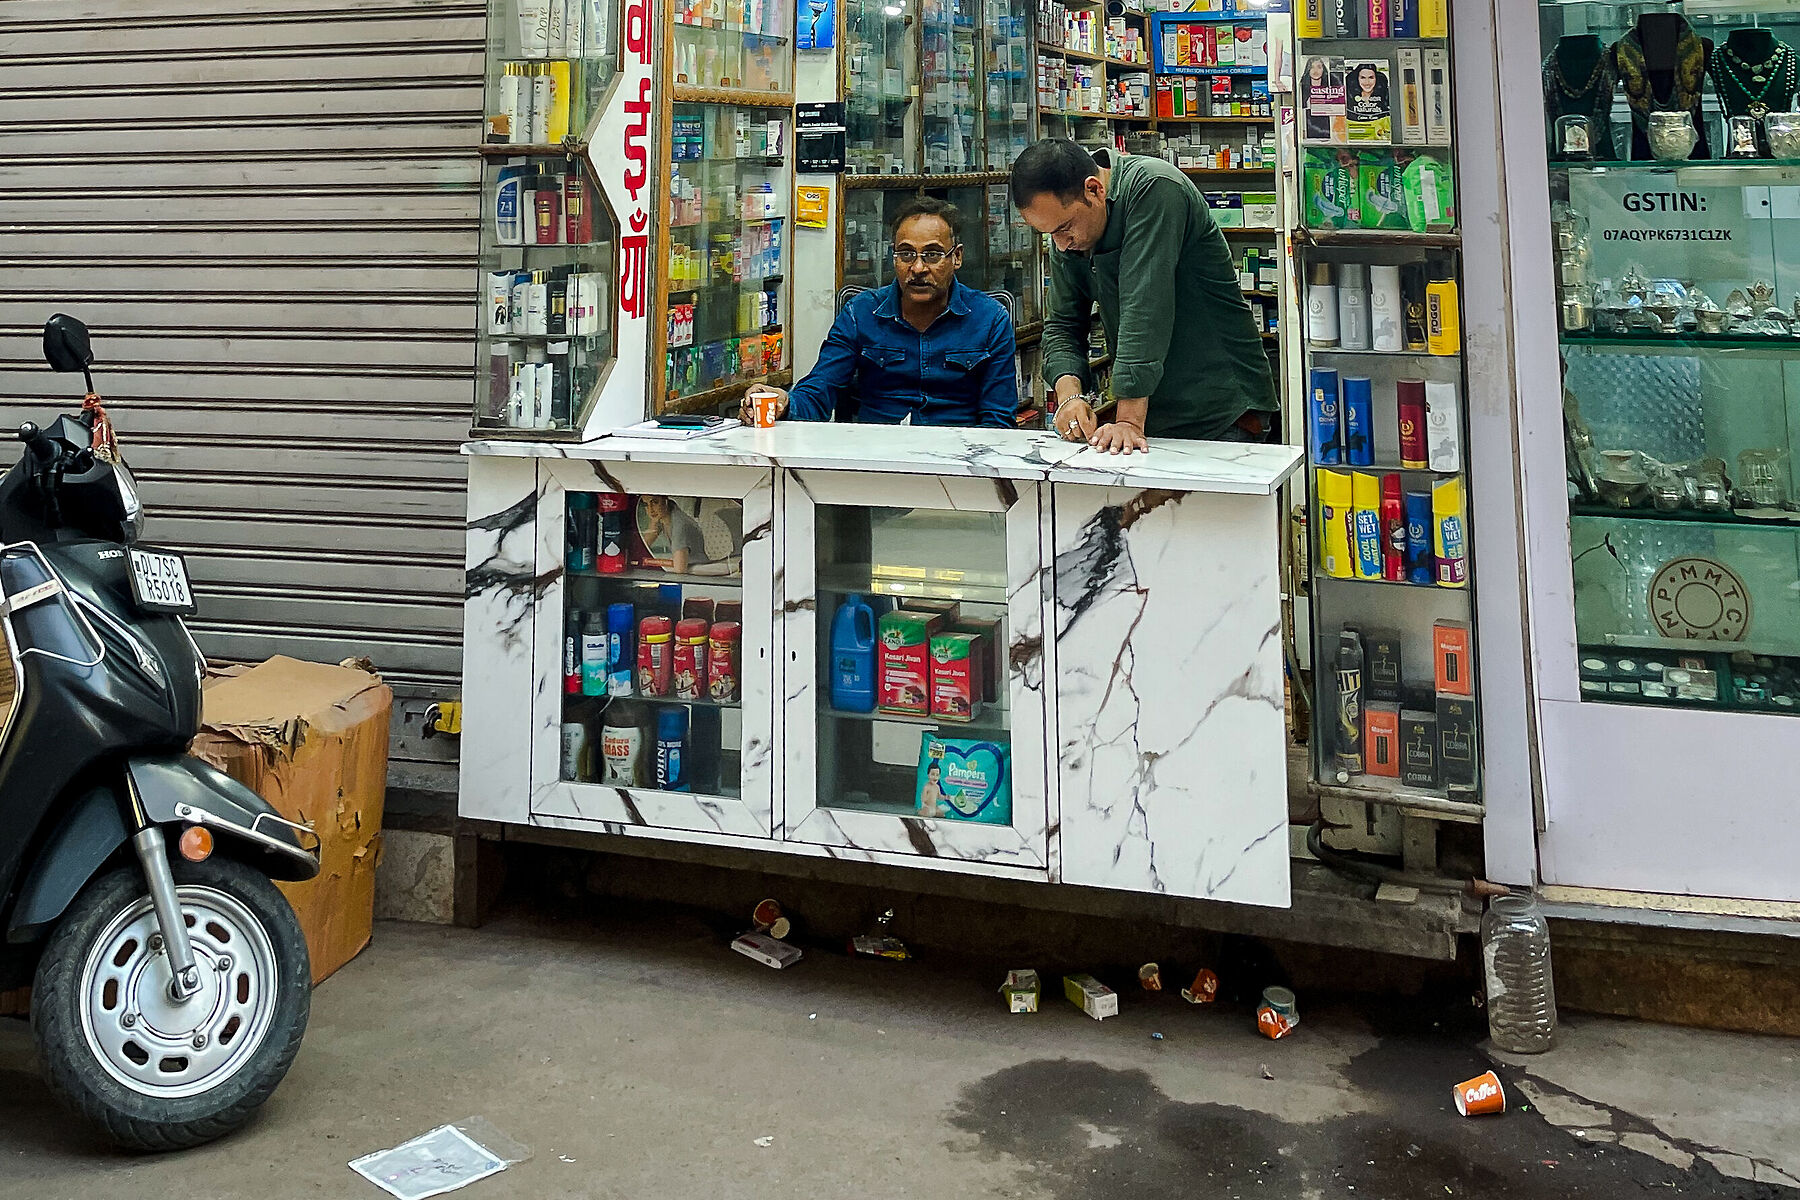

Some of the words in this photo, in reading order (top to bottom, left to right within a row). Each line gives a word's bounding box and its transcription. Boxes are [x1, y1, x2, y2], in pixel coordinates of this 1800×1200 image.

[536, 6, 549, 41] Dove
[1338, 168, 1348, 204] whisper
[1622, 192, 1708, 212] GSTIN:
[1603, 229, 1732, 242] 07AQYPK6731C1ZK
[1357, 514, 1374, 524] SET
[1359, 523, 1376, 534] WET
[140, 554, 179, 578] DL7SC
[884, 652, 904, 661] Kesari
[604, 744, 630, 757] MASS
[948, 762, 986, 781] Pampers
[1407, 772, 1433, 782] COBRA
